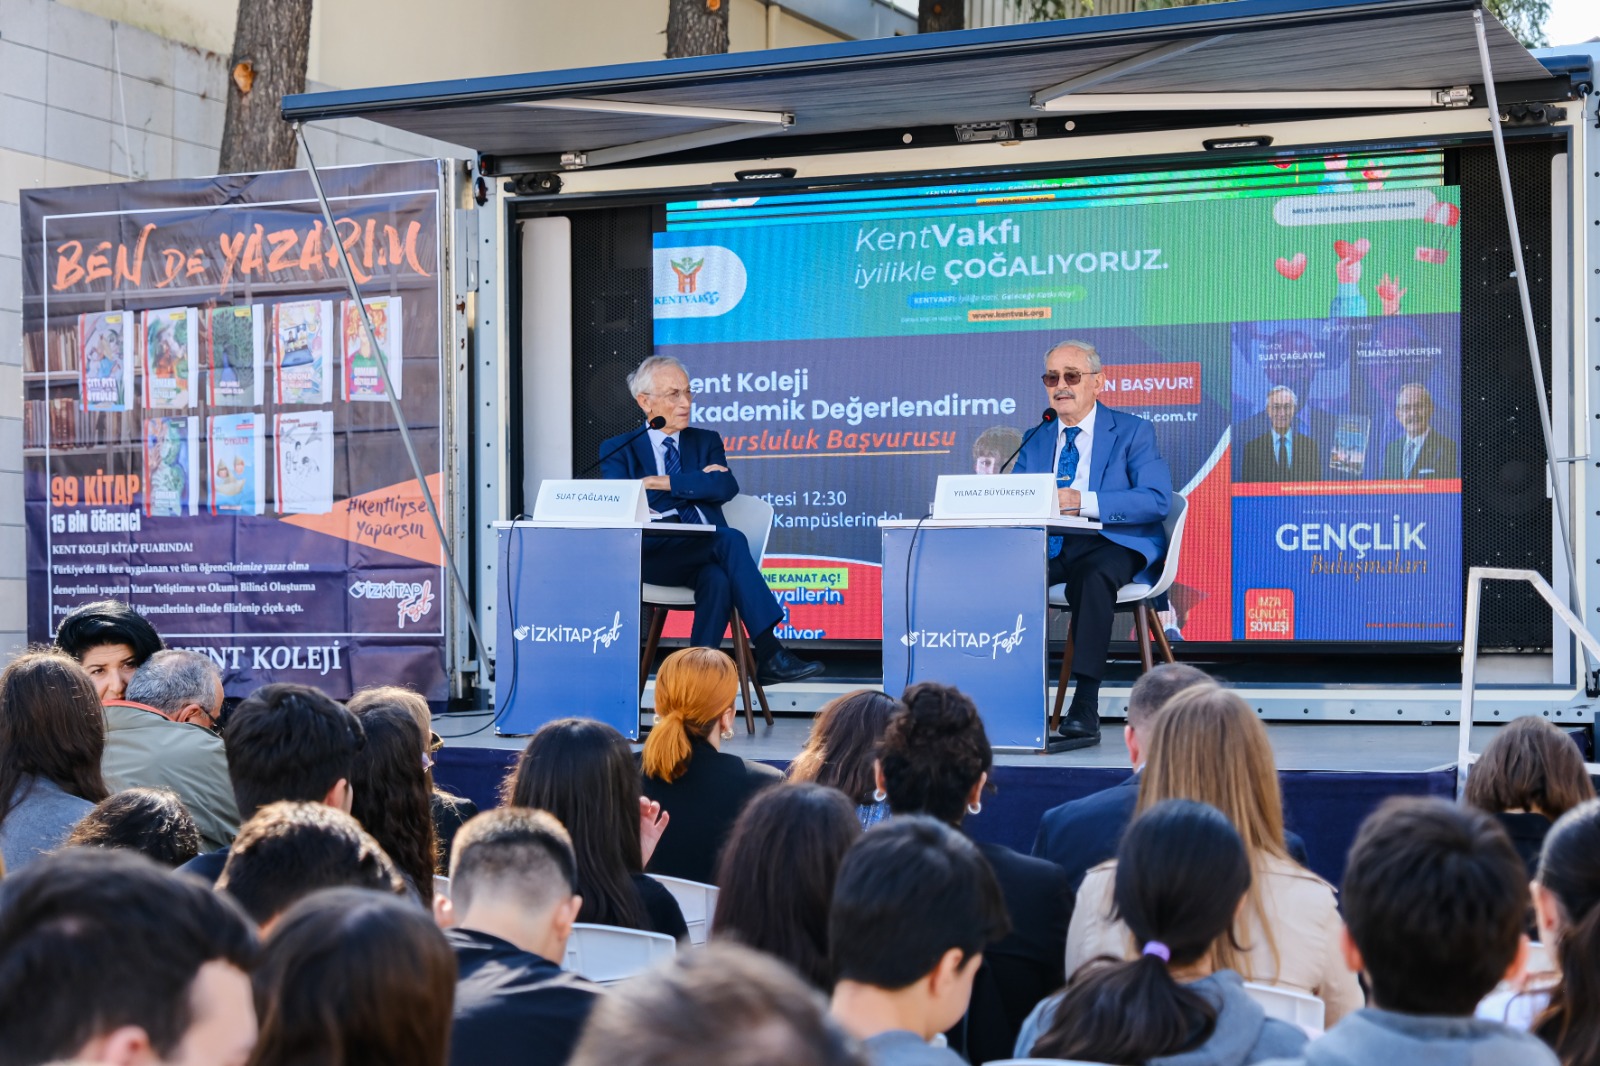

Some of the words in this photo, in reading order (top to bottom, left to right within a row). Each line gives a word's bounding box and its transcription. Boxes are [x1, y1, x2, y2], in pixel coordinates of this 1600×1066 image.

[854, 217, 1020, 253] KentVakfı
[53, 223, 157, 291] BEN
[155, 248, 205, 289] DE
[854, 260, 937, 289] iyilikle
[943, 248, 1168, 287] ÇOĞALIYORUZ.
[688, 372, 733, 394] ent
[737, 368, 809, 398] Koleji
[1121, 376, 1194, 393] BAŞVUR!
[690, 398, 806, 423] kademik
[811, 393, 1017, 426] Değerlendirme
[722, 428, 821, 453] ursluluk
[826, 427, 957, 454] Başvurusu
[51, 476, 79, 507] 99
[84, 468, 140, 506] KİTAP
[556, 492, 576, 501] SUAT
[577, 492, 620, 503] ÇAĞLAYAN
[802, 490, 847, 507] 12:30
[953, 489, 983, 498] YILMAZ
[984, 487, 1036, 498] BÜYÜKERŞEN
[51, 514, 66, 533] 15
[68, 509, 89, 533] BİN
[91, 508, 141, 533] ÖĞRENCİ
[53, 545, 77, 554] KENT
[79, 542, 110, 555] KOLEJİ
[112, 542, 139, 554] KİTAP
[140, 542, 194, 553] FUARINDA!
[1274, 514, 1428, 559] GENÇLİK
[53, 563, 95, 577] Türkiye'de
[96, 563, 108, 574] ilk
[109, 564, 124, 574] kez
[126, 563, 169, 576] uygulanan
[170, 565, 180, 573] ve
[181, 563, 198, 573] tüm
[199, 561, 263, 575] öğrencilerimize
[264, 564, 286, 574] yazar
[287, 561, 310, 572] olma
[779, 573, 818, 583] KANAT
[820, 573, 841, 586] AÇ!
[1310, 551, 1428, 583] Buluşmaları
[53, 584, 99, 597] deneyimini
[100, 584, 130, 597] yaşatan
[131, 583, 153, 594] Yazar
[154, 583, 196, 596] Yetiştirme
[197, 585, 207, 593] ve
[208, 582, 239, 593] Okuma
[240, 582, 268, 592] Bilinci
[269, 581, 317, 594] Oluşturma
[771, 585, 842, 604] yallerin
[136, 603, 195, 617] öğrencilerinin
[195, 602, 222, 614] elinde
[223, 602, 261, 616] filizlenip
[262, 602, 285, 615] çiçek
[286, 603, 305, 615] açtı.
[531, 624, 593, 643] İZKİTAP
[592, 611, 624, 655] Fest
[921, 629, 991, 648] İZKİTAP
[991, 613, 1027, 660] Fest
[253, 640, 343, 676] KOLEJİ
